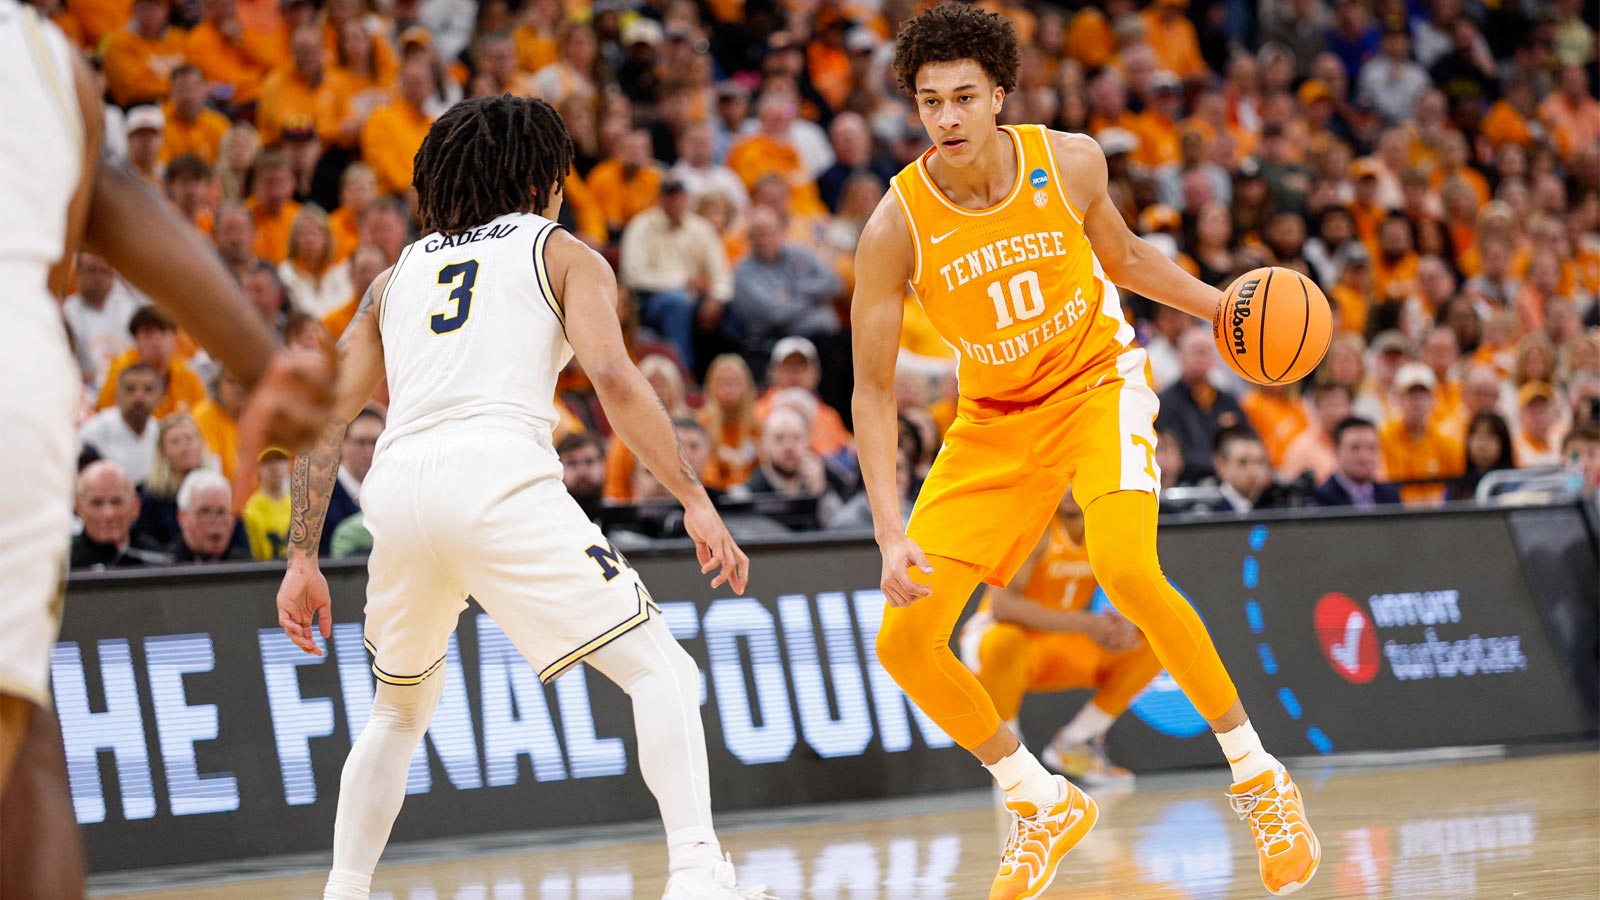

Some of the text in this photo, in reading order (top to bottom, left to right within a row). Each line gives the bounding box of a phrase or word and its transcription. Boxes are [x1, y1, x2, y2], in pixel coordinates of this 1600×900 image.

[425, 224, 518, 253] CADEAU
[940, 231, 1067, 292] TENNESSEE
[430, 257, 480, 336] 3
[959, 287, 1088, 366] VOLUNTEERS
[987, 270, 1046, 330] 10
[1232, 278, 1261, 355] Wilson
[584, 543, 632, 582] M
[51, 633, 239, 824] HE
[259, 613, 627, 806] FINAL
